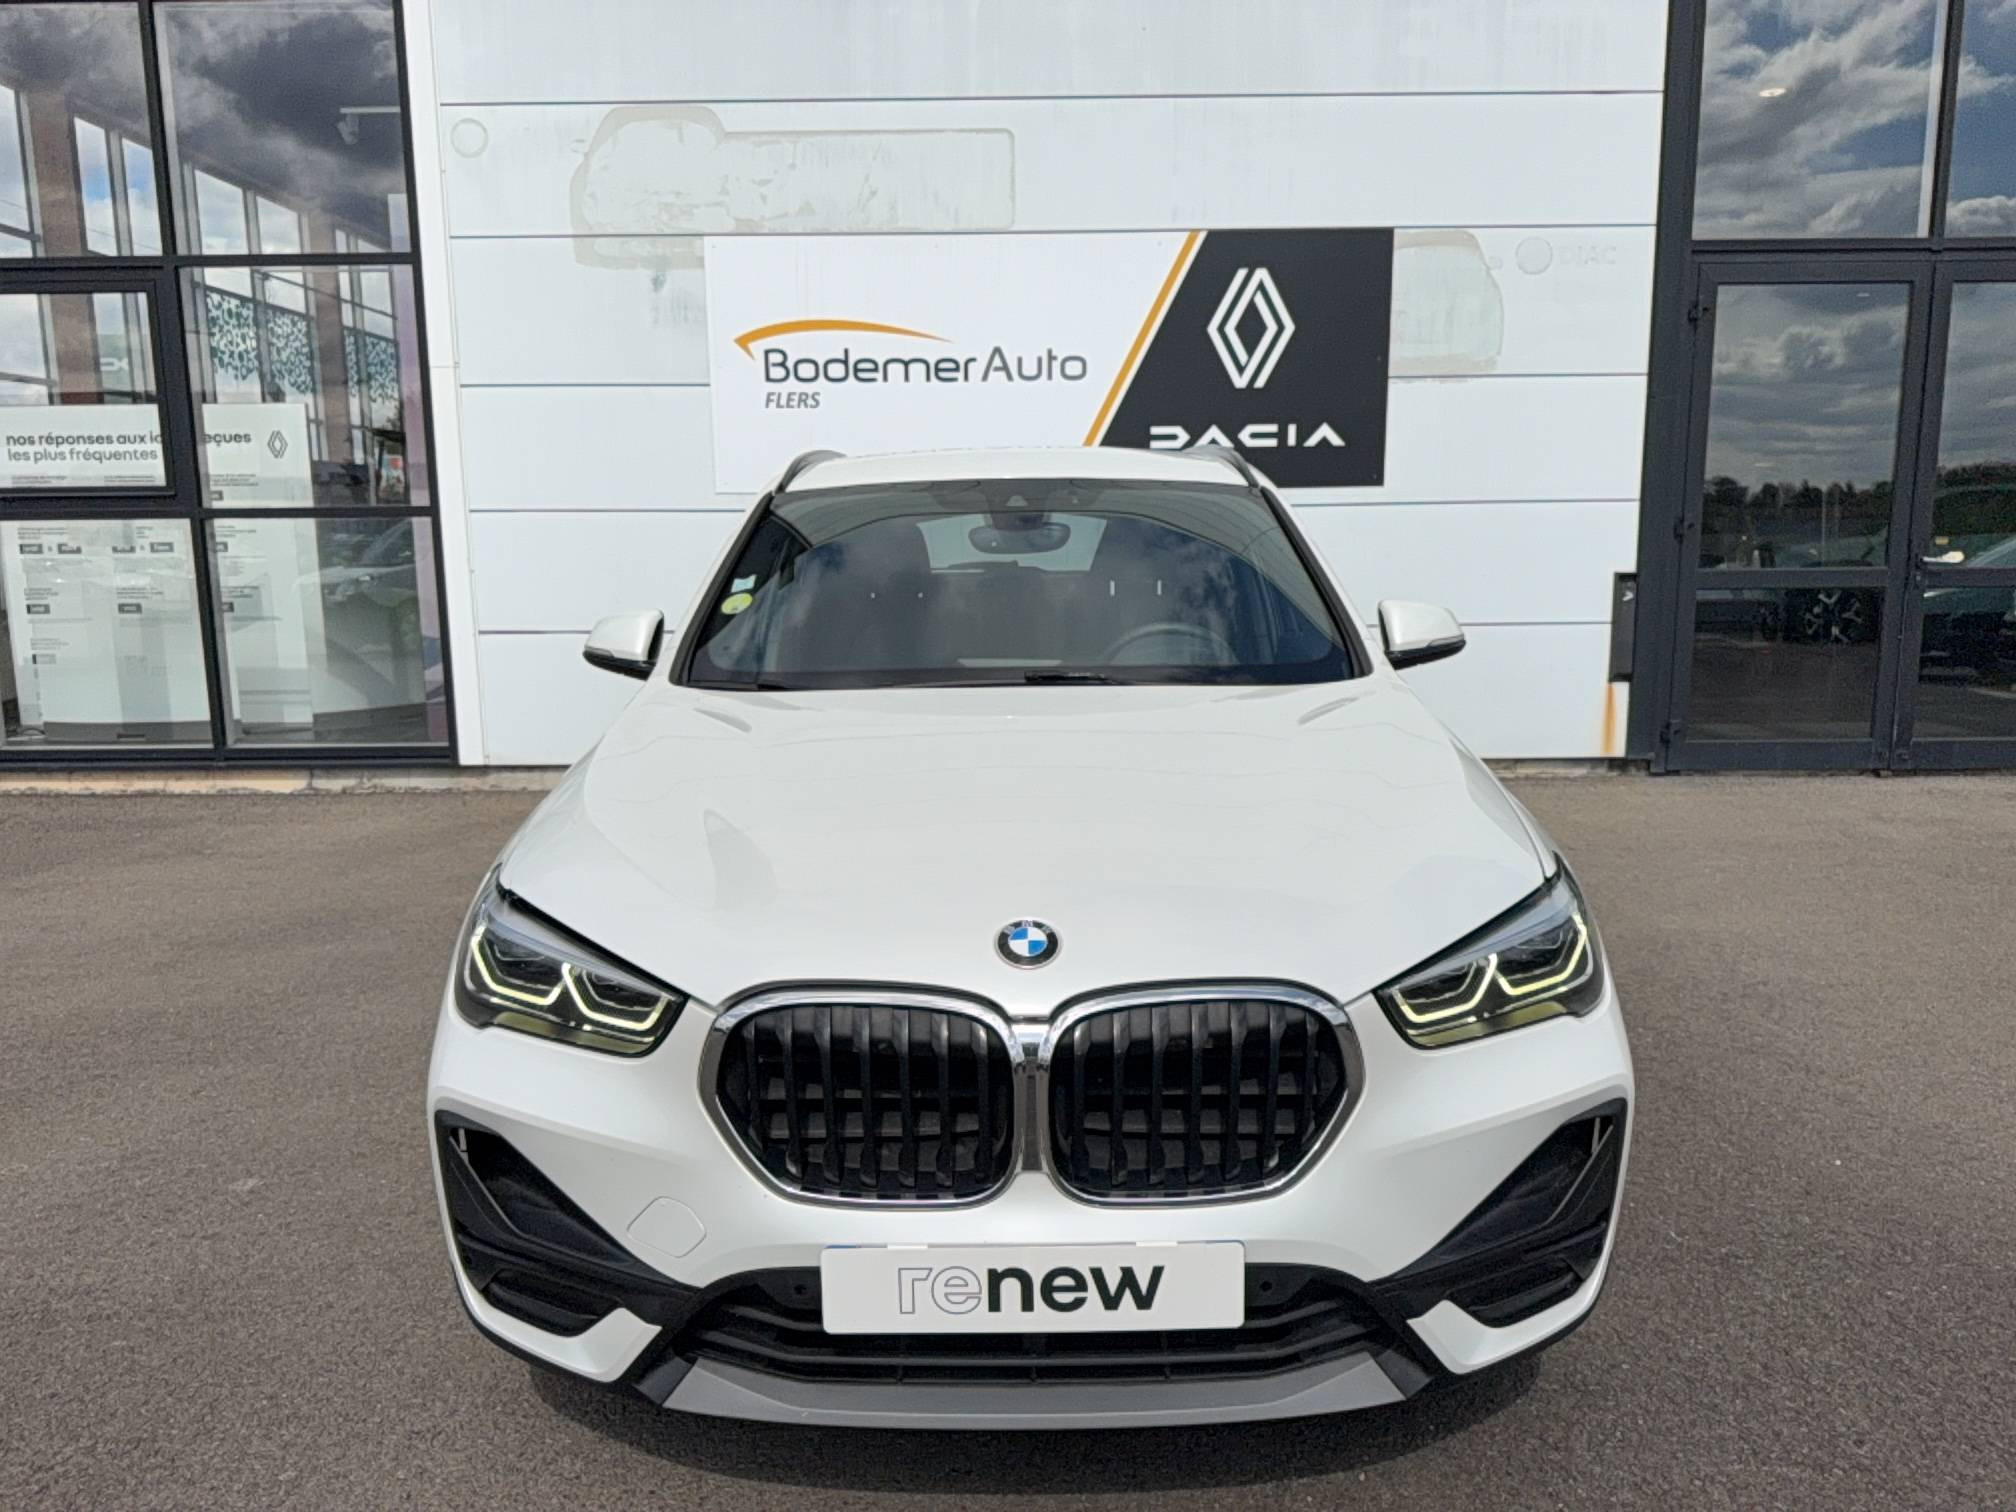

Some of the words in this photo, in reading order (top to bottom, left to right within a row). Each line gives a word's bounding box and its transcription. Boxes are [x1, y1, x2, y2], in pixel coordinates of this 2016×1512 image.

[765, 391, 821, 409] FLERS
[6, 434, 36, 446] nos
[38, 431, 115, 448] réponses
[116, 434, 147, 445] aux
[201, 432, 252, 447] eçues
[1149, 421, 1346, 449] DACIA
[7, 447, 31, 462] les
[33, 447, 67, 464] plus
[69, 447, 158, 464] fréquentes
[897, 1264, 1165, 1315] renew
